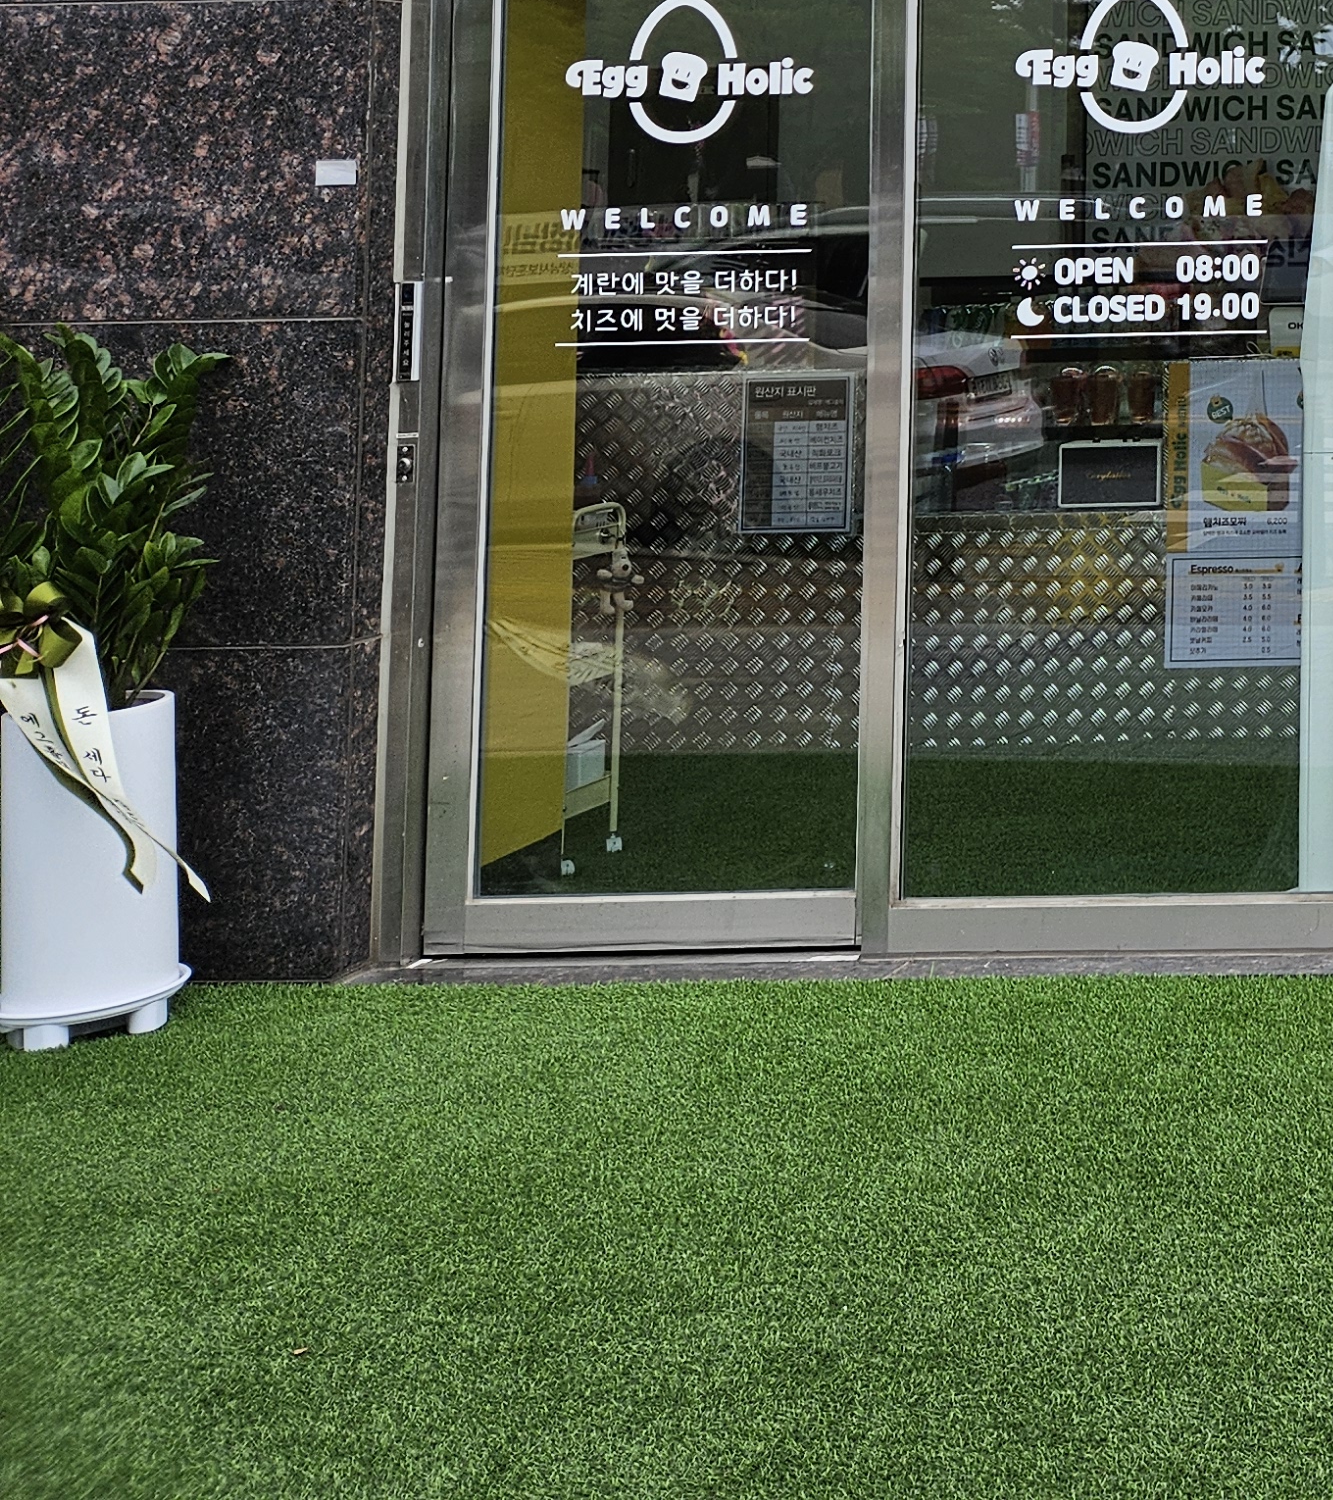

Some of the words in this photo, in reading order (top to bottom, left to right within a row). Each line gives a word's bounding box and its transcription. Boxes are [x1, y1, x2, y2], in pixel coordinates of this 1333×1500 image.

[565, 59, 649, 98] Egg
[717, 57, 814, 96] Holic
[1015, 49, 1099, 88] Egg
[1169, 46, 1266, 86] Holic
[560, 203, 808, 230] WELCOME
[1015, 194, 1263, 222] WELCOME
[571, 272, 645, 296] 계란에
[655, 270, 704, 295] 맛을
[714, 269, 798, 293] 더하다!
[1054, 256, 1134, 285] OPEN
[1176, 254, 1260, 283] 08:00
[570, 308, 643, 332] 치즈에
[654, 306, 702, 331] 멋을
[713, 305, 797, 329] 더하다!
[1053, 294, 1166, 324] CLOSED
[1176, 292, 1260, 321] 19.00
[755, 386, 784, 398] 원산지
[787, 385, 816, 397] 표시판
[1212, 405, 1231, 419] BEST
[1172, 433, 1187, 467] Holic
[1190, 565, 1234, 576] Espresso
